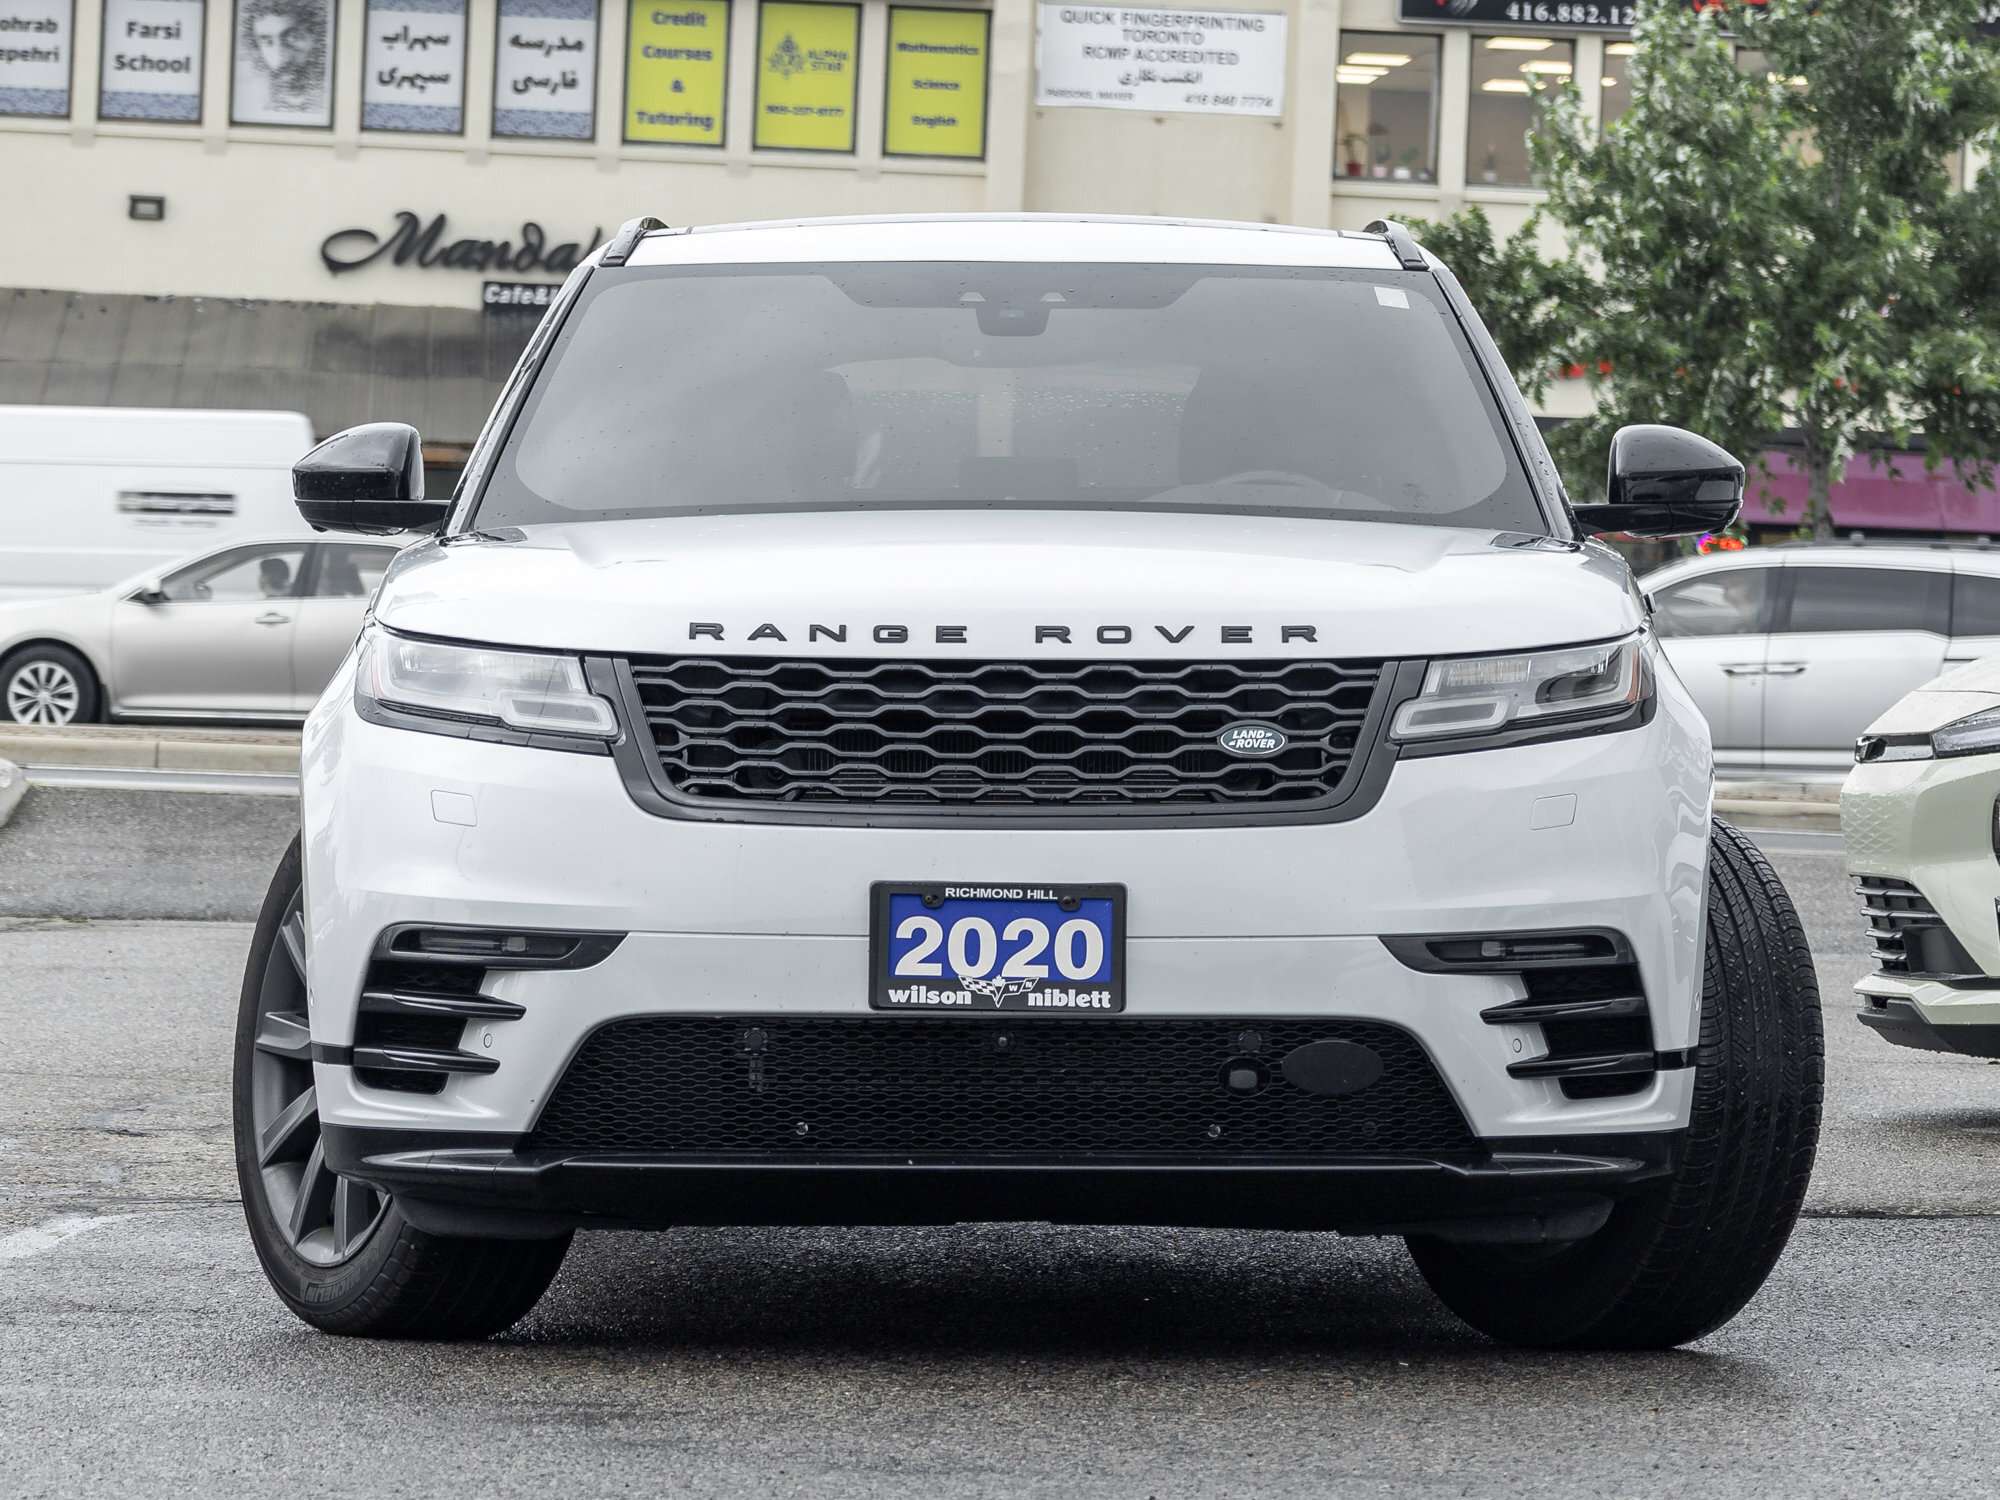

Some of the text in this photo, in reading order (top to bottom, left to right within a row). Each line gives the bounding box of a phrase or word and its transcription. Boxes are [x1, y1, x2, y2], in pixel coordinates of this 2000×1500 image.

[651, 10, 707, 28] Credit
[1060, 10, 1266, 32] QUICK FINGERPRINTING
[126, 21, 182, 40] Farsi
[381, 25, 450, 51] سهراب
[1122, 28, 1206, 46] TORONTO
[509, 33, 584, 57] مدرسه
[642, 45, 713, 62] Courses
[1082, 45, 1240, 66] RCMP ACCREDITED
[114, 53, 191, 74] School
[512, 70, 579, 95] فارسی
[671, 79, 684, 93] &
[635, 110, 714, 132] Tutoring
[689, 622, 1319, 645] RANGE ROVER
[1232, 729, 1265, 739] LAND
[1235, 738, 1276, 749] ROVER
[944, 887, 1058, 900] RICHMOND HILL
[894, 915, 1104, 980] 2020
[888, 984, 1111, 1009] wilson niblett
